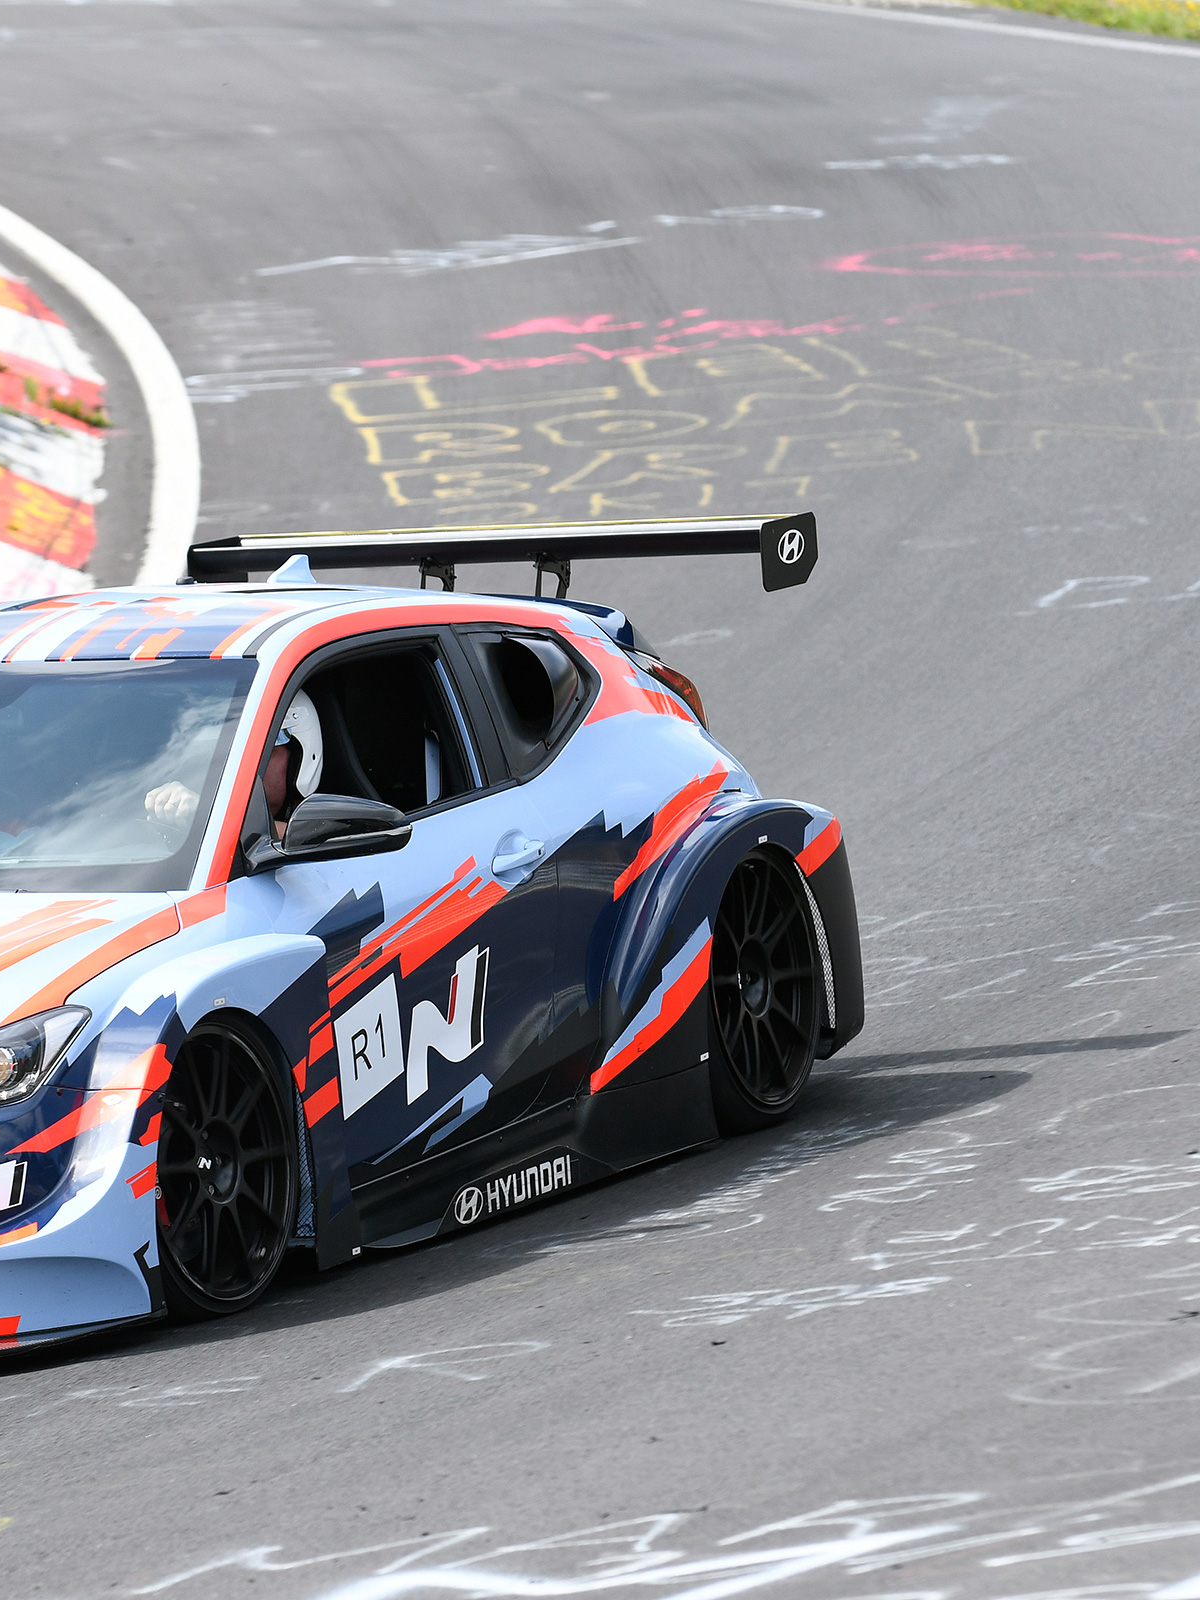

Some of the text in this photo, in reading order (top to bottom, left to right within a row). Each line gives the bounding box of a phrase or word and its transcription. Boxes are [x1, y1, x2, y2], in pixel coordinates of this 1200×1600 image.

[350, 1012, 387, 1081] R1
[406, 944, 490, 1106] N
[486, 1154, 573, 1214] HYUNDAI
